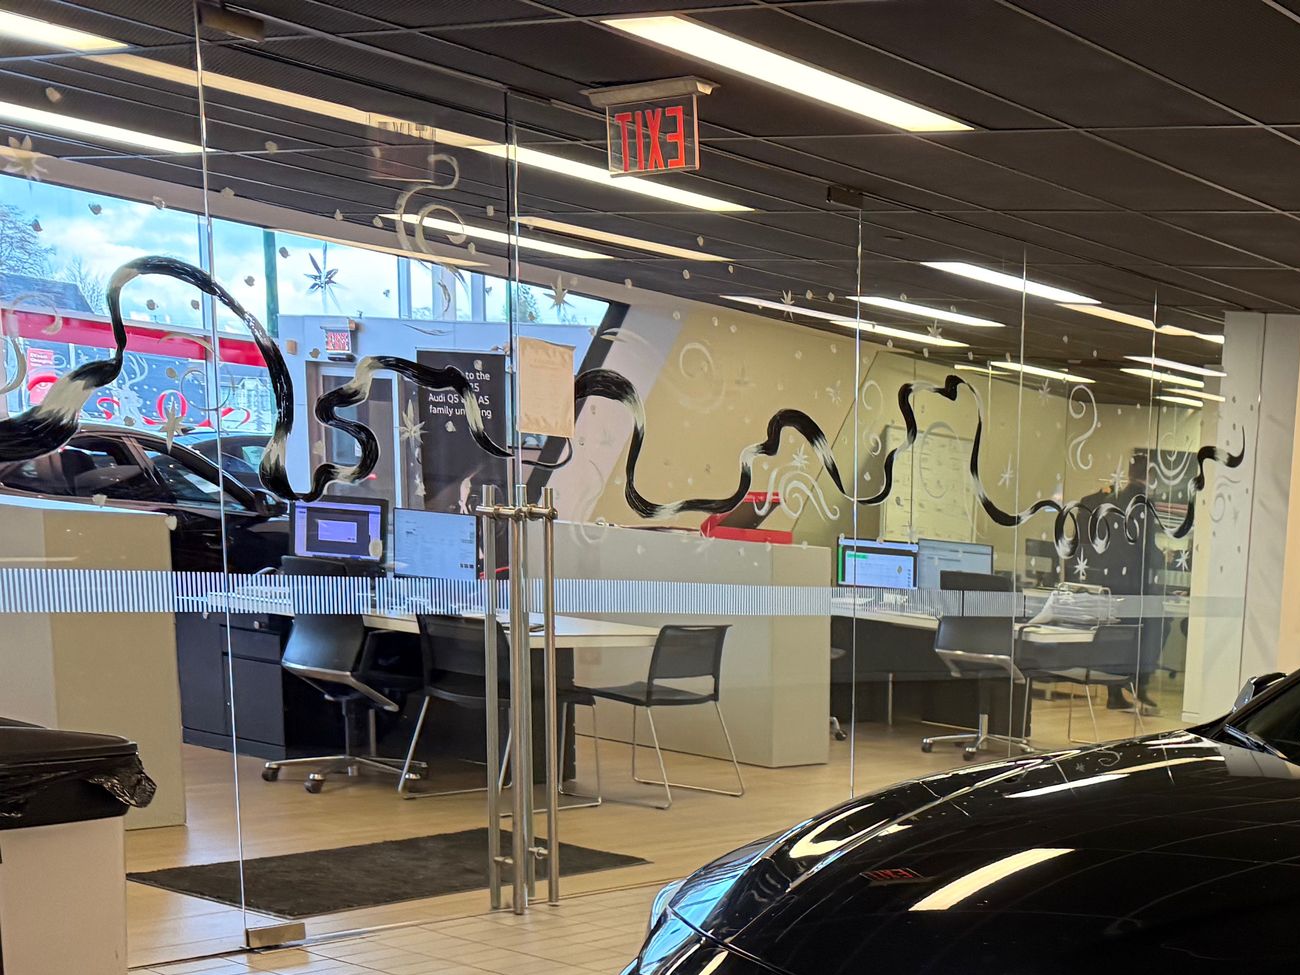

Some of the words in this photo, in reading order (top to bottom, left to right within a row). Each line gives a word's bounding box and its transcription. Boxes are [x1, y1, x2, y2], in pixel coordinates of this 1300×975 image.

[465, 372, 475, 380] to
[476, 371, 491, 381] the
[428, 393, 446, 403] Audi
[447, 393, 459, 404] Q5
[478, 395, 490, 405] A5
[429, 405, 454, 417] family
